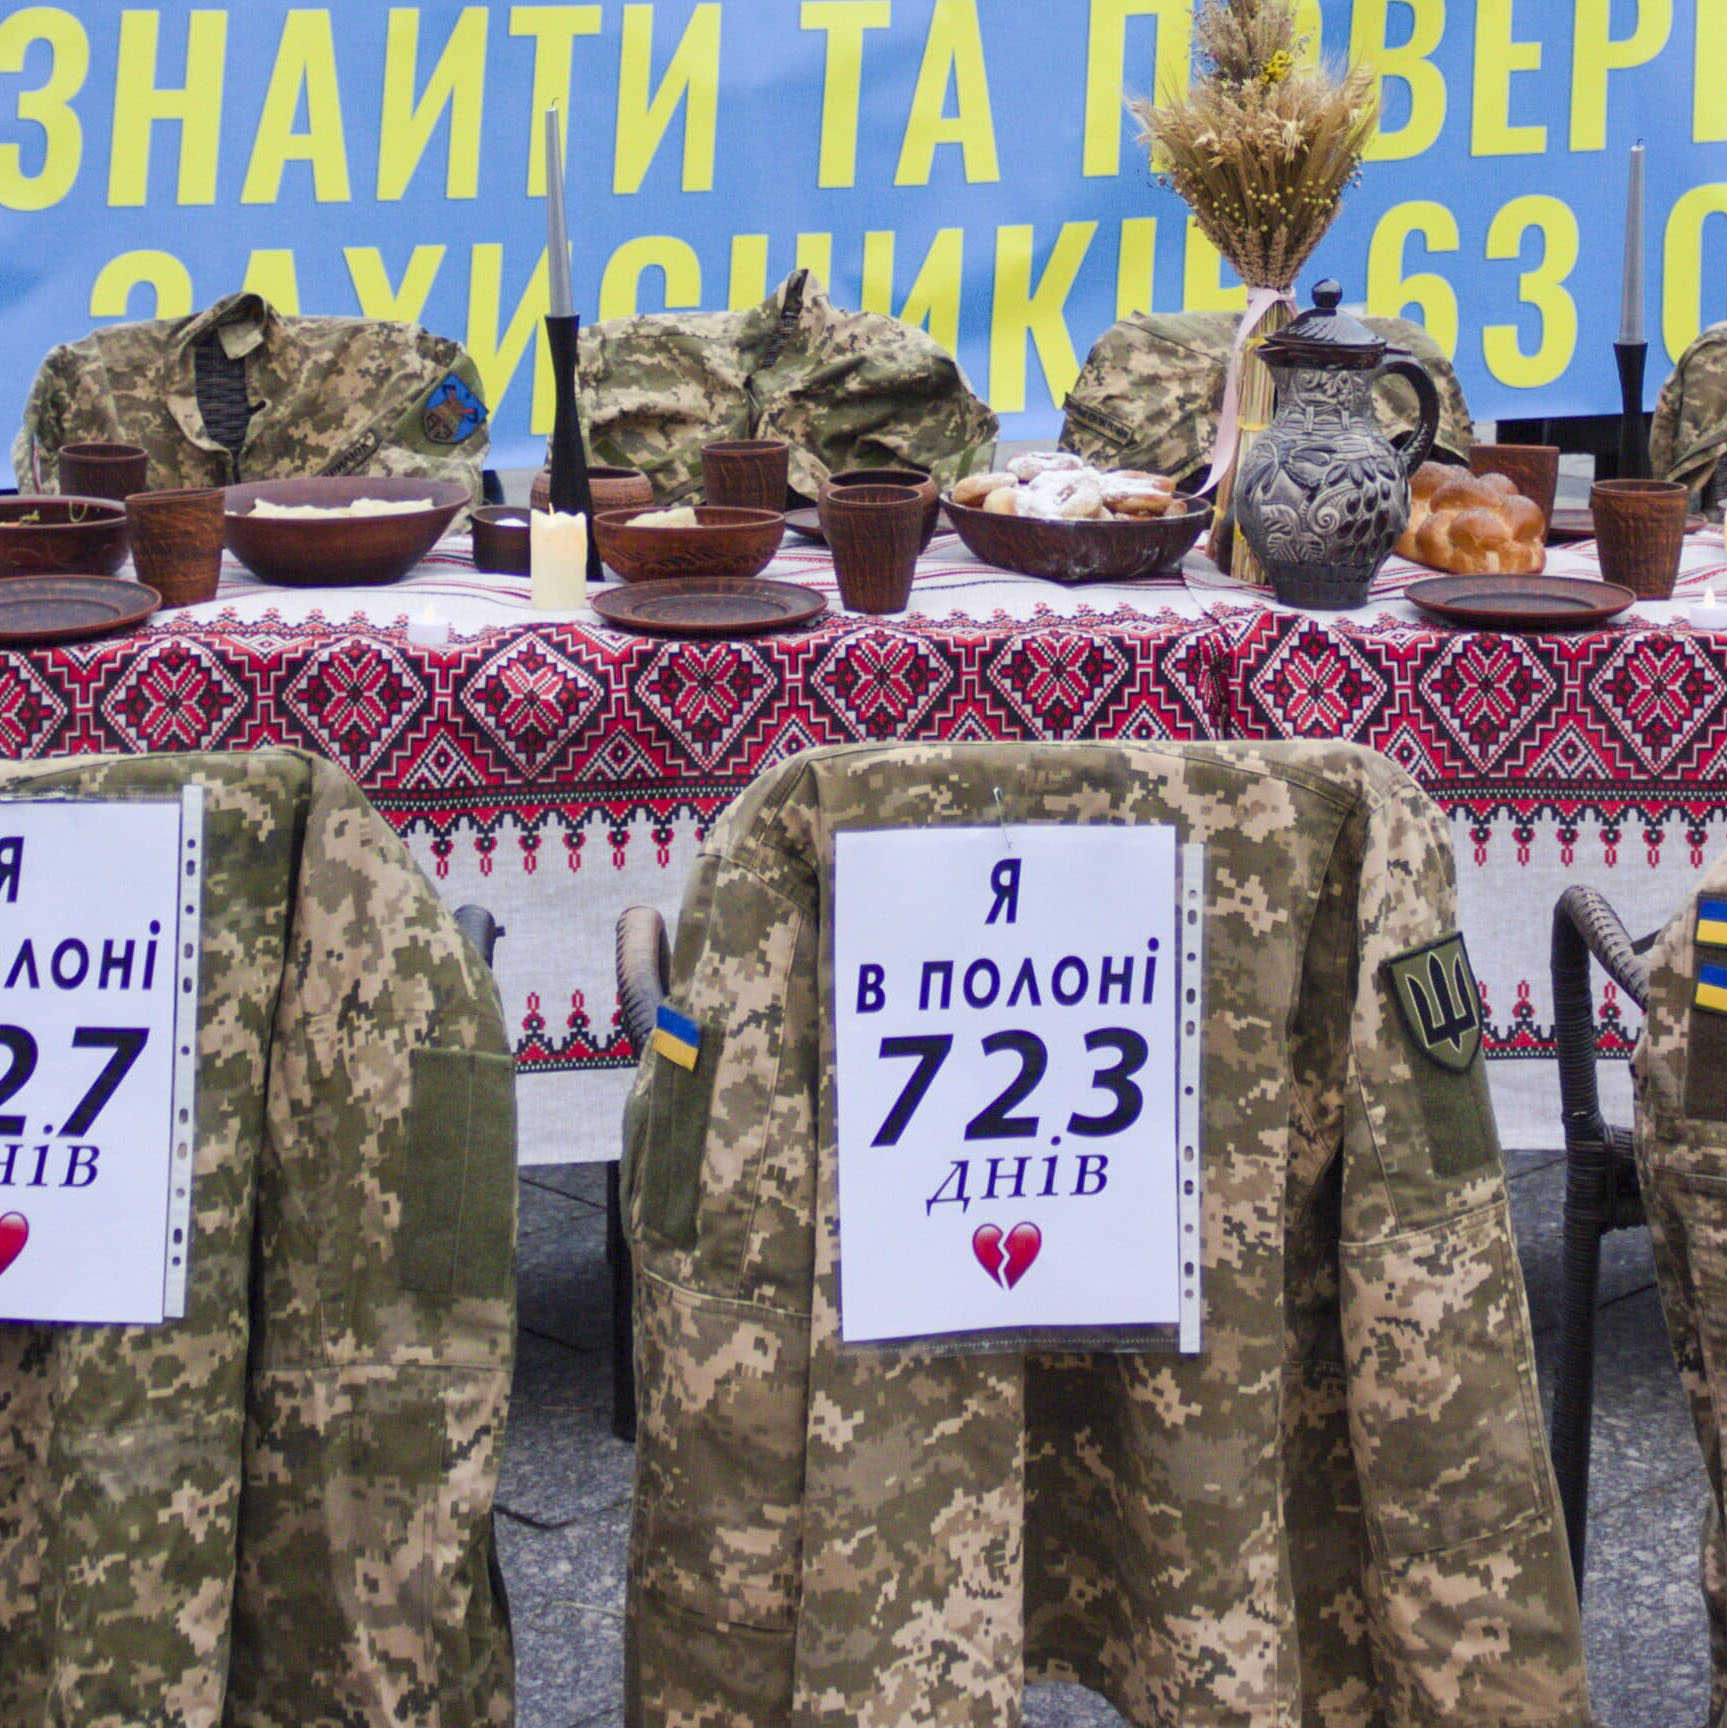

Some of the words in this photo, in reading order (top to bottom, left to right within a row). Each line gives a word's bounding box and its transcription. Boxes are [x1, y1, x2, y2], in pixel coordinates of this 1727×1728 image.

[1365, 194, 1580, 389] 63
[985, 858, 1022, 925] Я
[918, 937, 1160, 1011] полоні
[870, 1027, 1149, 1148] 723
[926, 1135, 1109, 1216] днів
